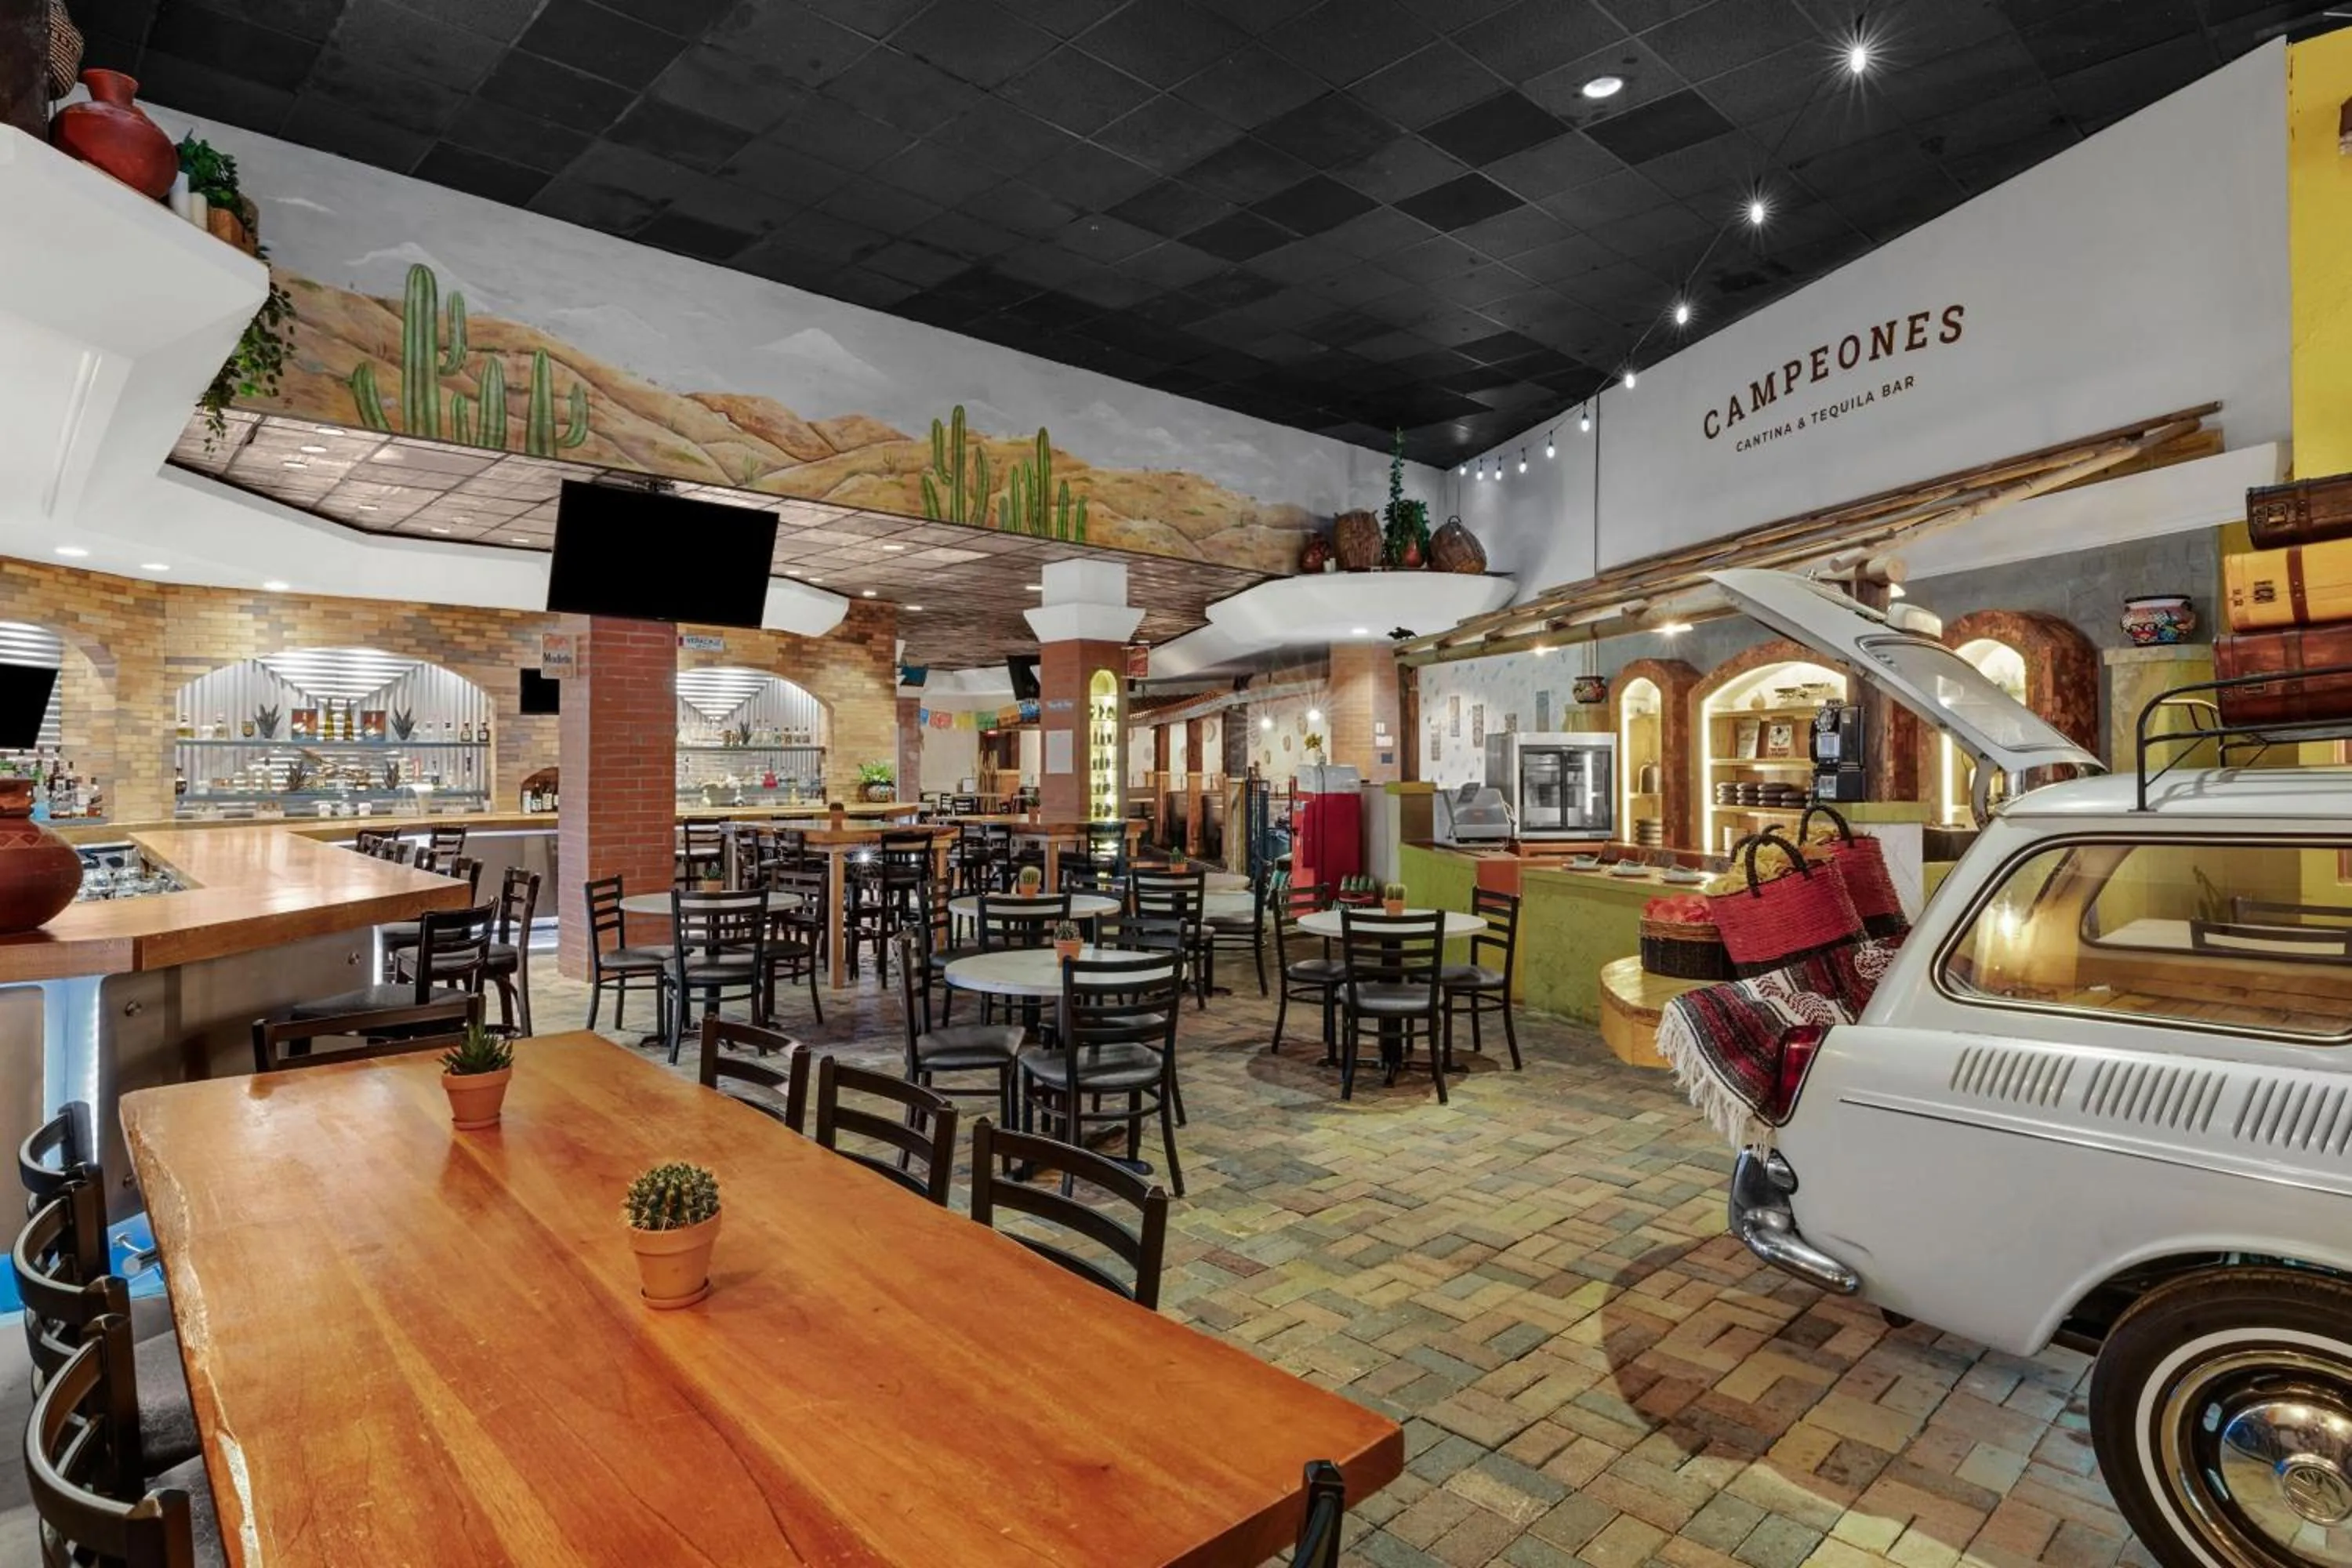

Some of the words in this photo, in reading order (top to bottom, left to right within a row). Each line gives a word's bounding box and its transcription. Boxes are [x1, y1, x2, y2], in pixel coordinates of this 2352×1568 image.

[1703, 303, 1965, 440] CAMPEONES
[1735, 423, 1793, 452] CANTINA
[1797, 416, 1806, 430] &
[1810, 390, 1875, 424] TEQUILA
[1882, 375, 1915, 397] BAR
